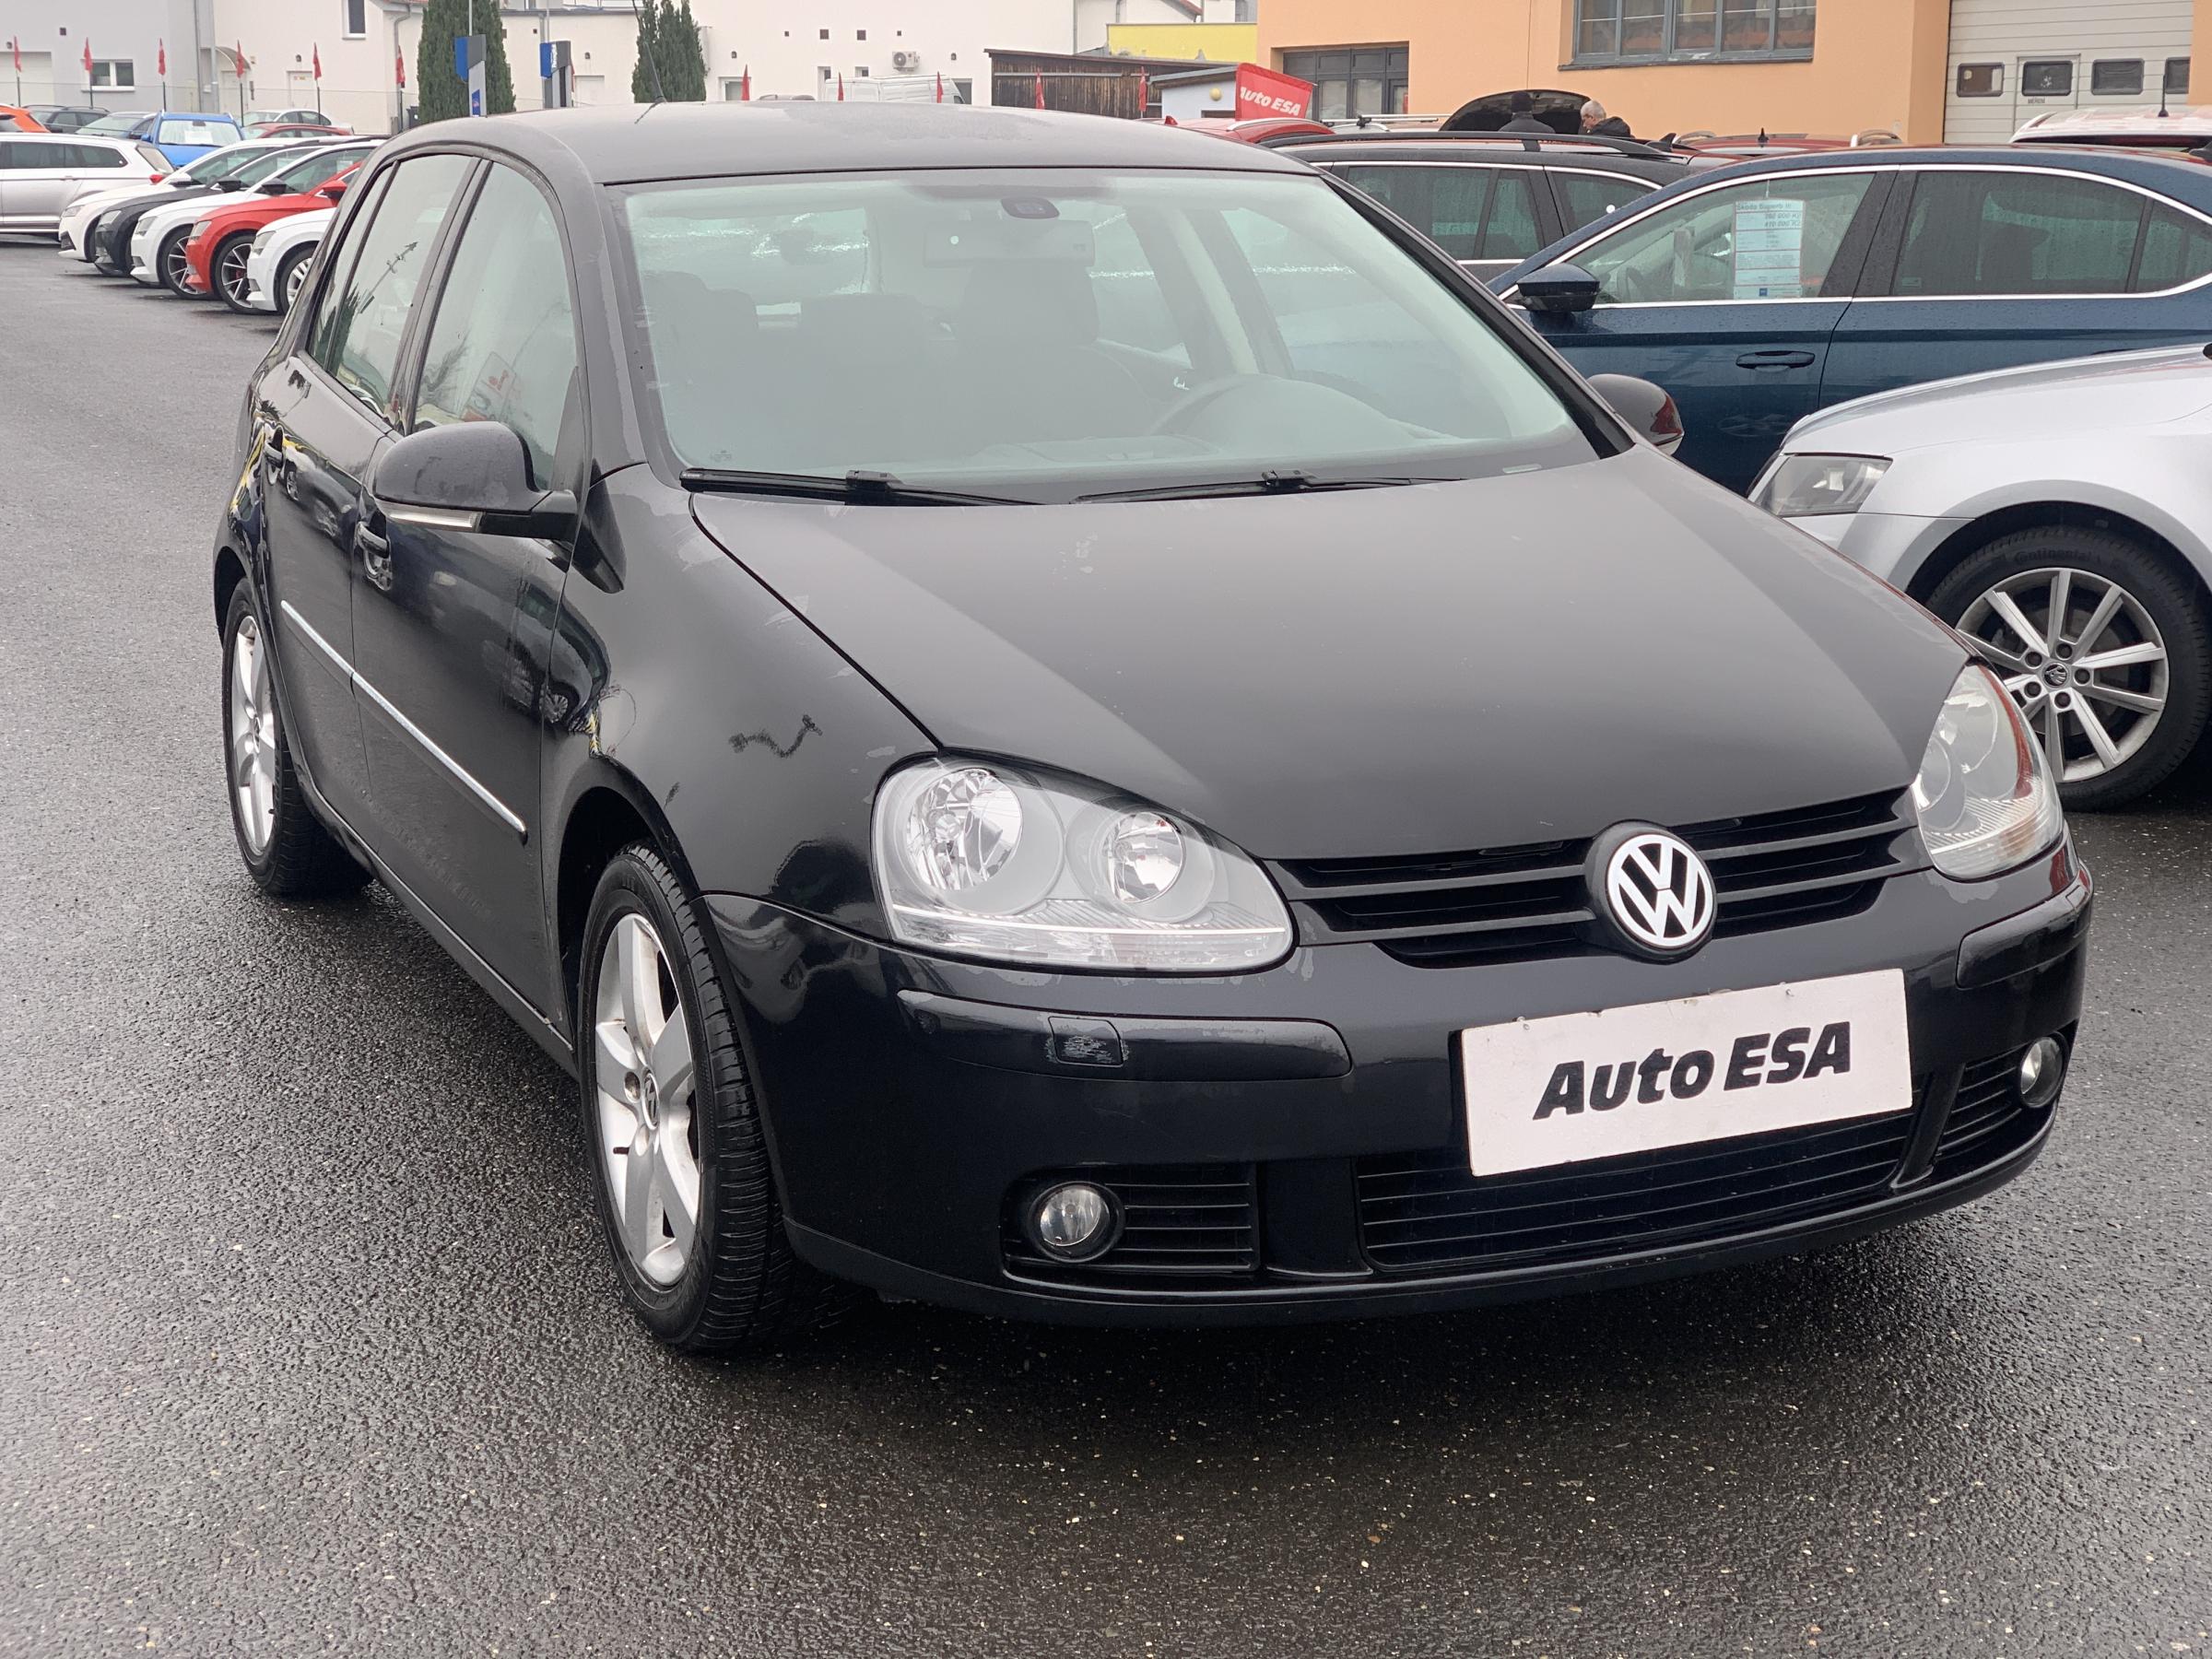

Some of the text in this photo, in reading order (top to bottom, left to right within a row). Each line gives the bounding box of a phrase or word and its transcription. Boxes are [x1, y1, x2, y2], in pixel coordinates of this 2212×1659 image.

[1271, 98, 1301, 116] ESA
[2014, 547, 2091, 564] Continental
[1608, 834, 1712, 947] VW
[1533, 1021, 1851, 1120] Auto ESA
